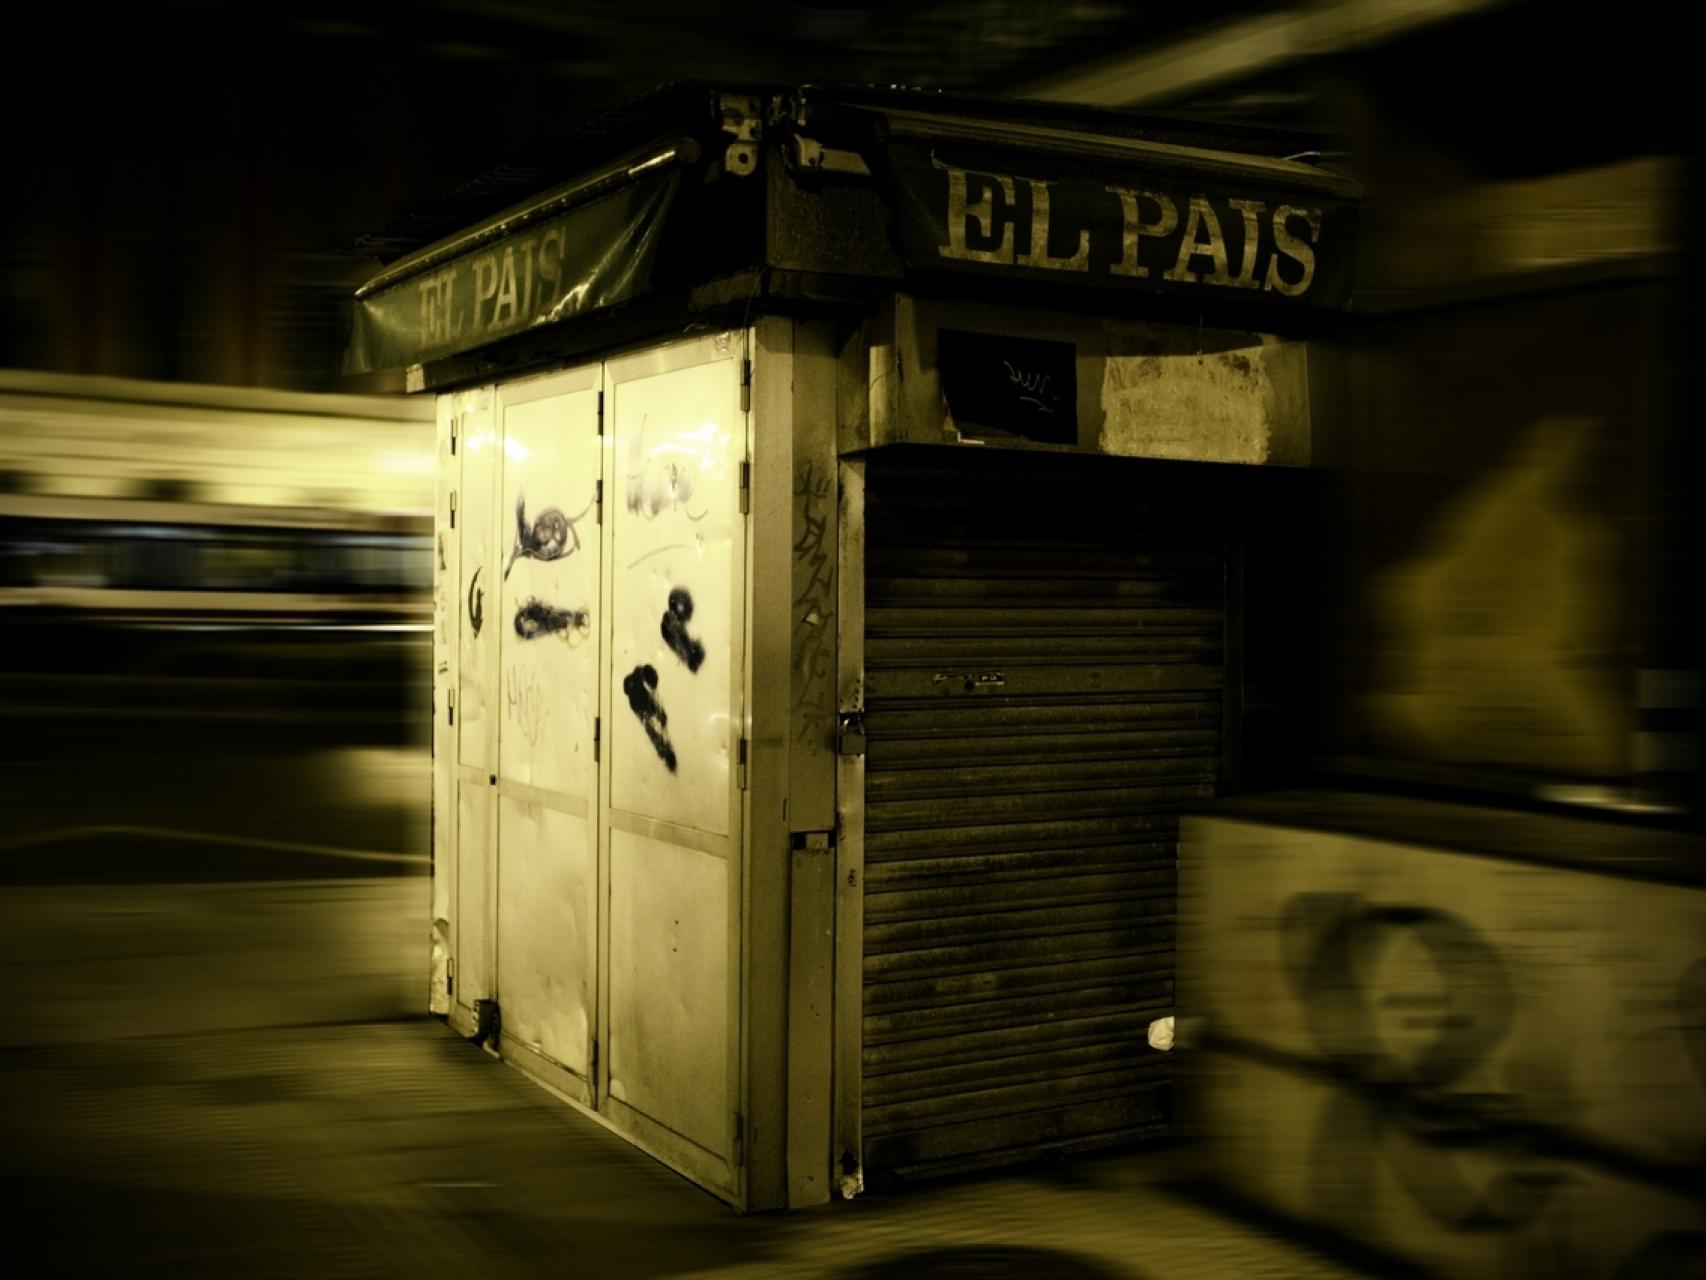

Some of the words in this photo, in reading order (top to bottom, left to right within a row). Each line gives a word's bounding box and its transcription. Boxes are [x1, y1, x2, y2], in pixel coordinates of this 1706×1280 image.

[419, 269, 463, 343] EL
[472, 227, 566, 334] PAIS
[938, 166, 1090, 273] EL
[1105, 184, 1322, 297] PAIS
